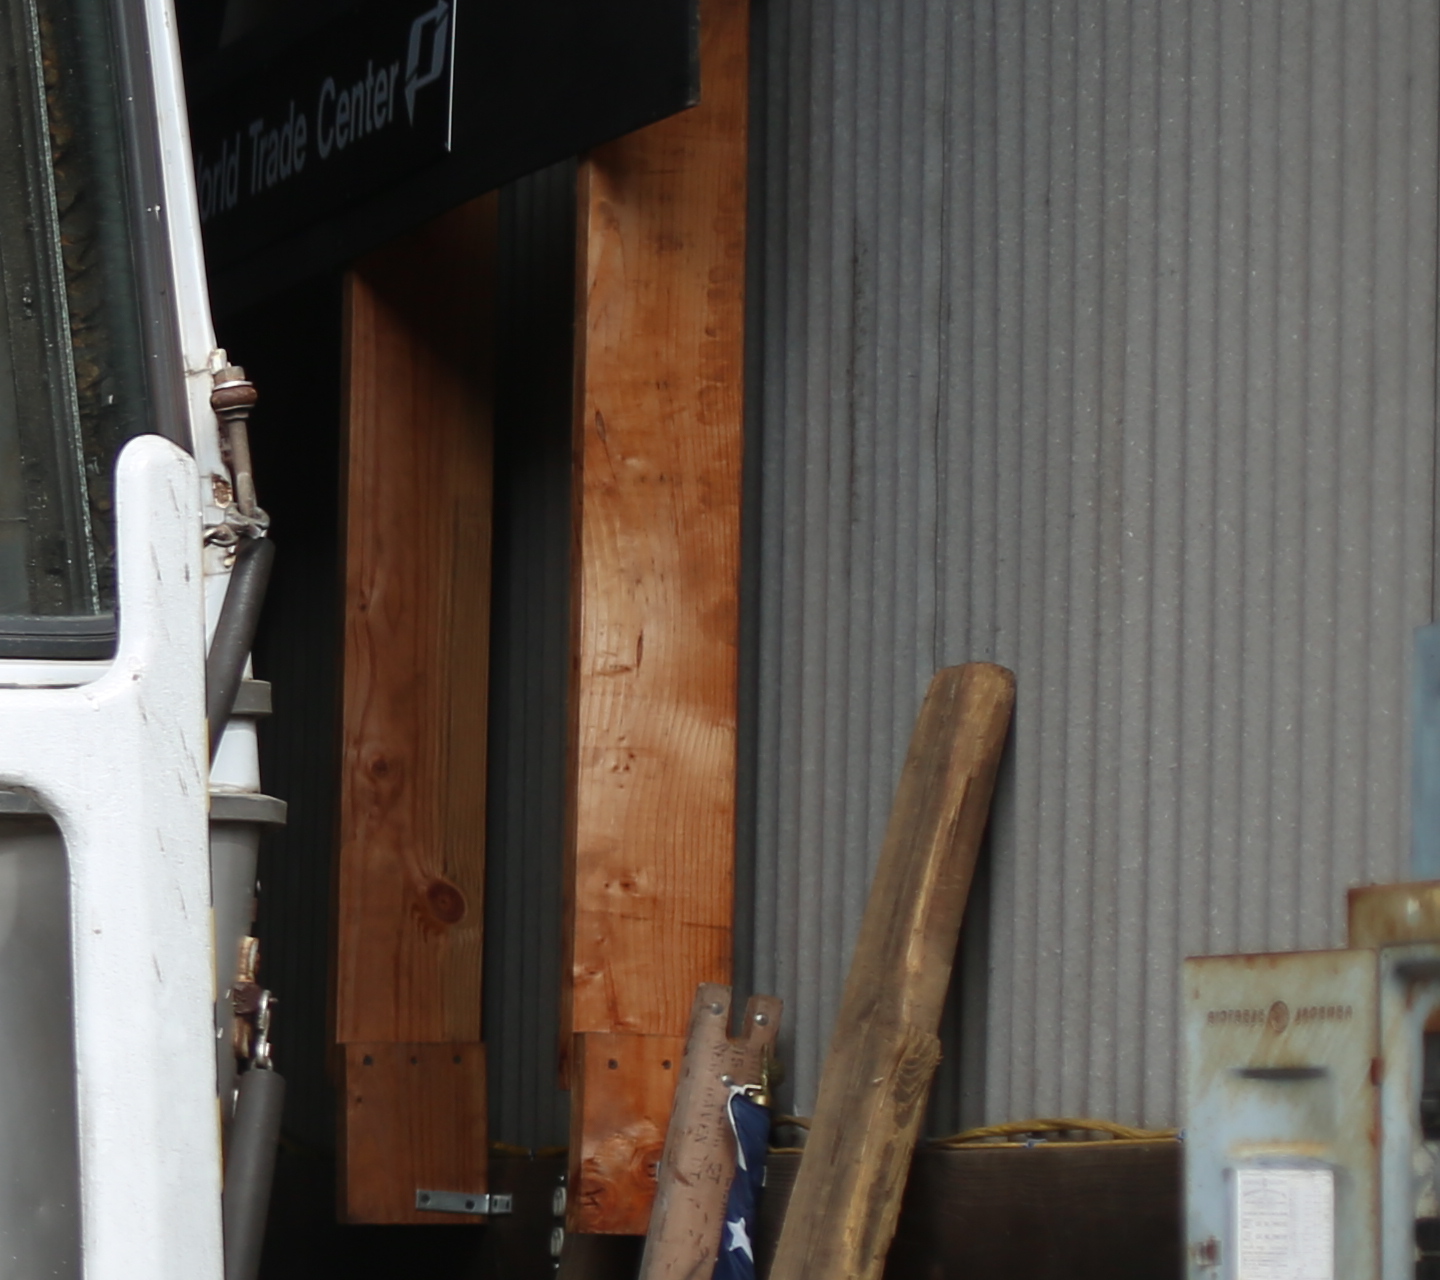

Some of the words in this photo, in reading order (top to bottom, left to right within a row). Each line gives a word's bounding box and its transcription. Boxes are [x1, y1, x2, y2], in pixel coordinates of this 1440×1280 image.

[197, 131, 241, 223] orld
[249, 99, 308, 196] Trade
[317, 58, 400, 159] Center
